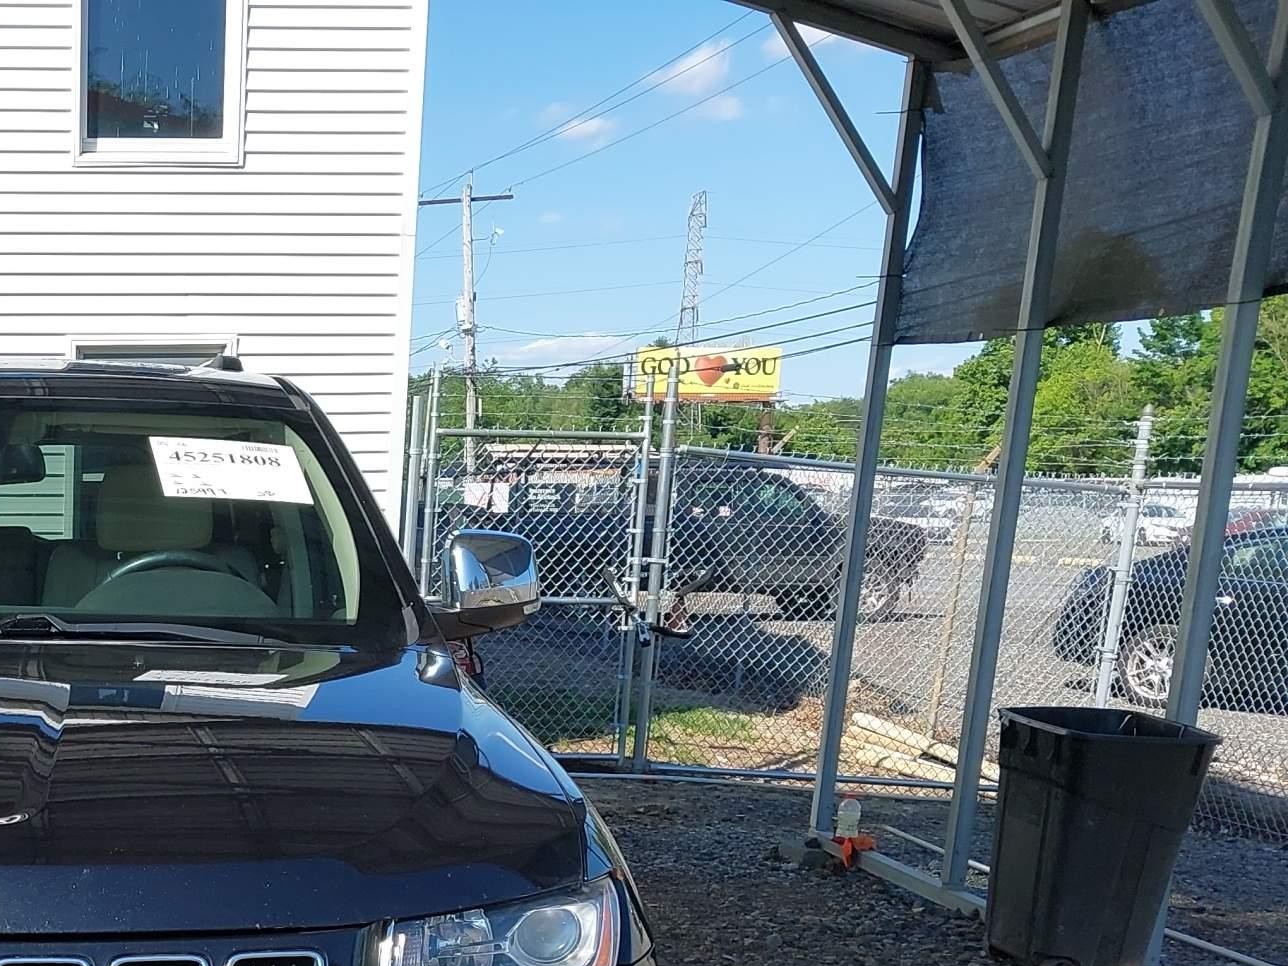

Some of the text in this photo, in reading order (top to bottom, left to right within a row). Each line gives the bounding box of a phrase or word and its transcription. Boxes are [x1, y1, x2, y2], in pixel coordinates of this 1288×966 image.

[641, 357, 777, 375] GOD YOU
[169, 450, 281, 467] 45251808
